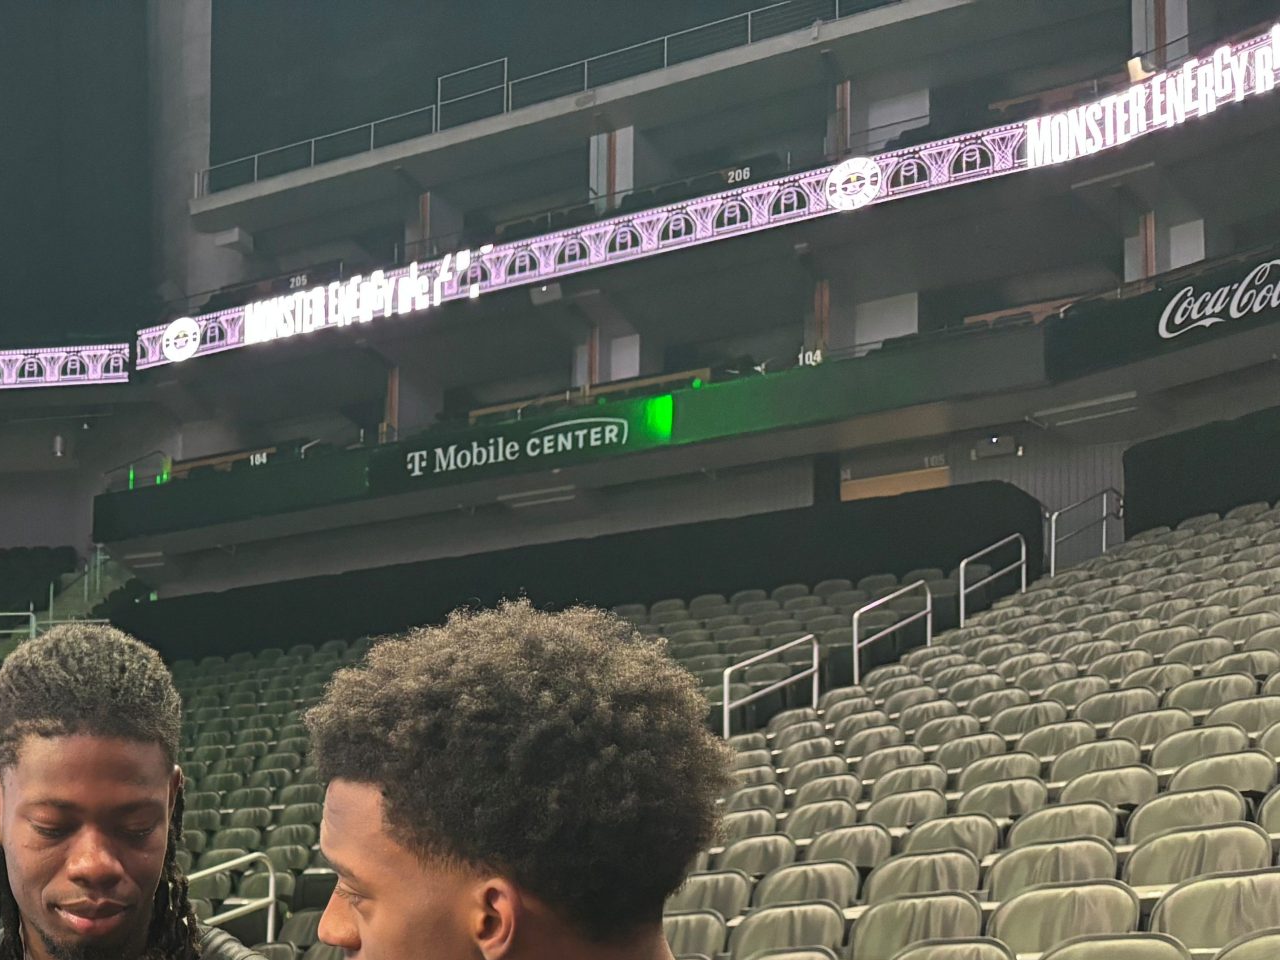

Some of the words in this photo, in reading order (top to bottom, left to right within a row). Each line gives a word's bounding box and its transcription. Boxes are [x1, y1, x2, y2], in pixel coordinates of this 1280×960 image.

[1026, 84, 1147, 168] MONSTER
[1151, 45, 1250, 128] ENERGY
[728, 167, 751, 184] 206
[433, 436, 520, 473] Mobile
[526, 424, 619, 457] CENTER
